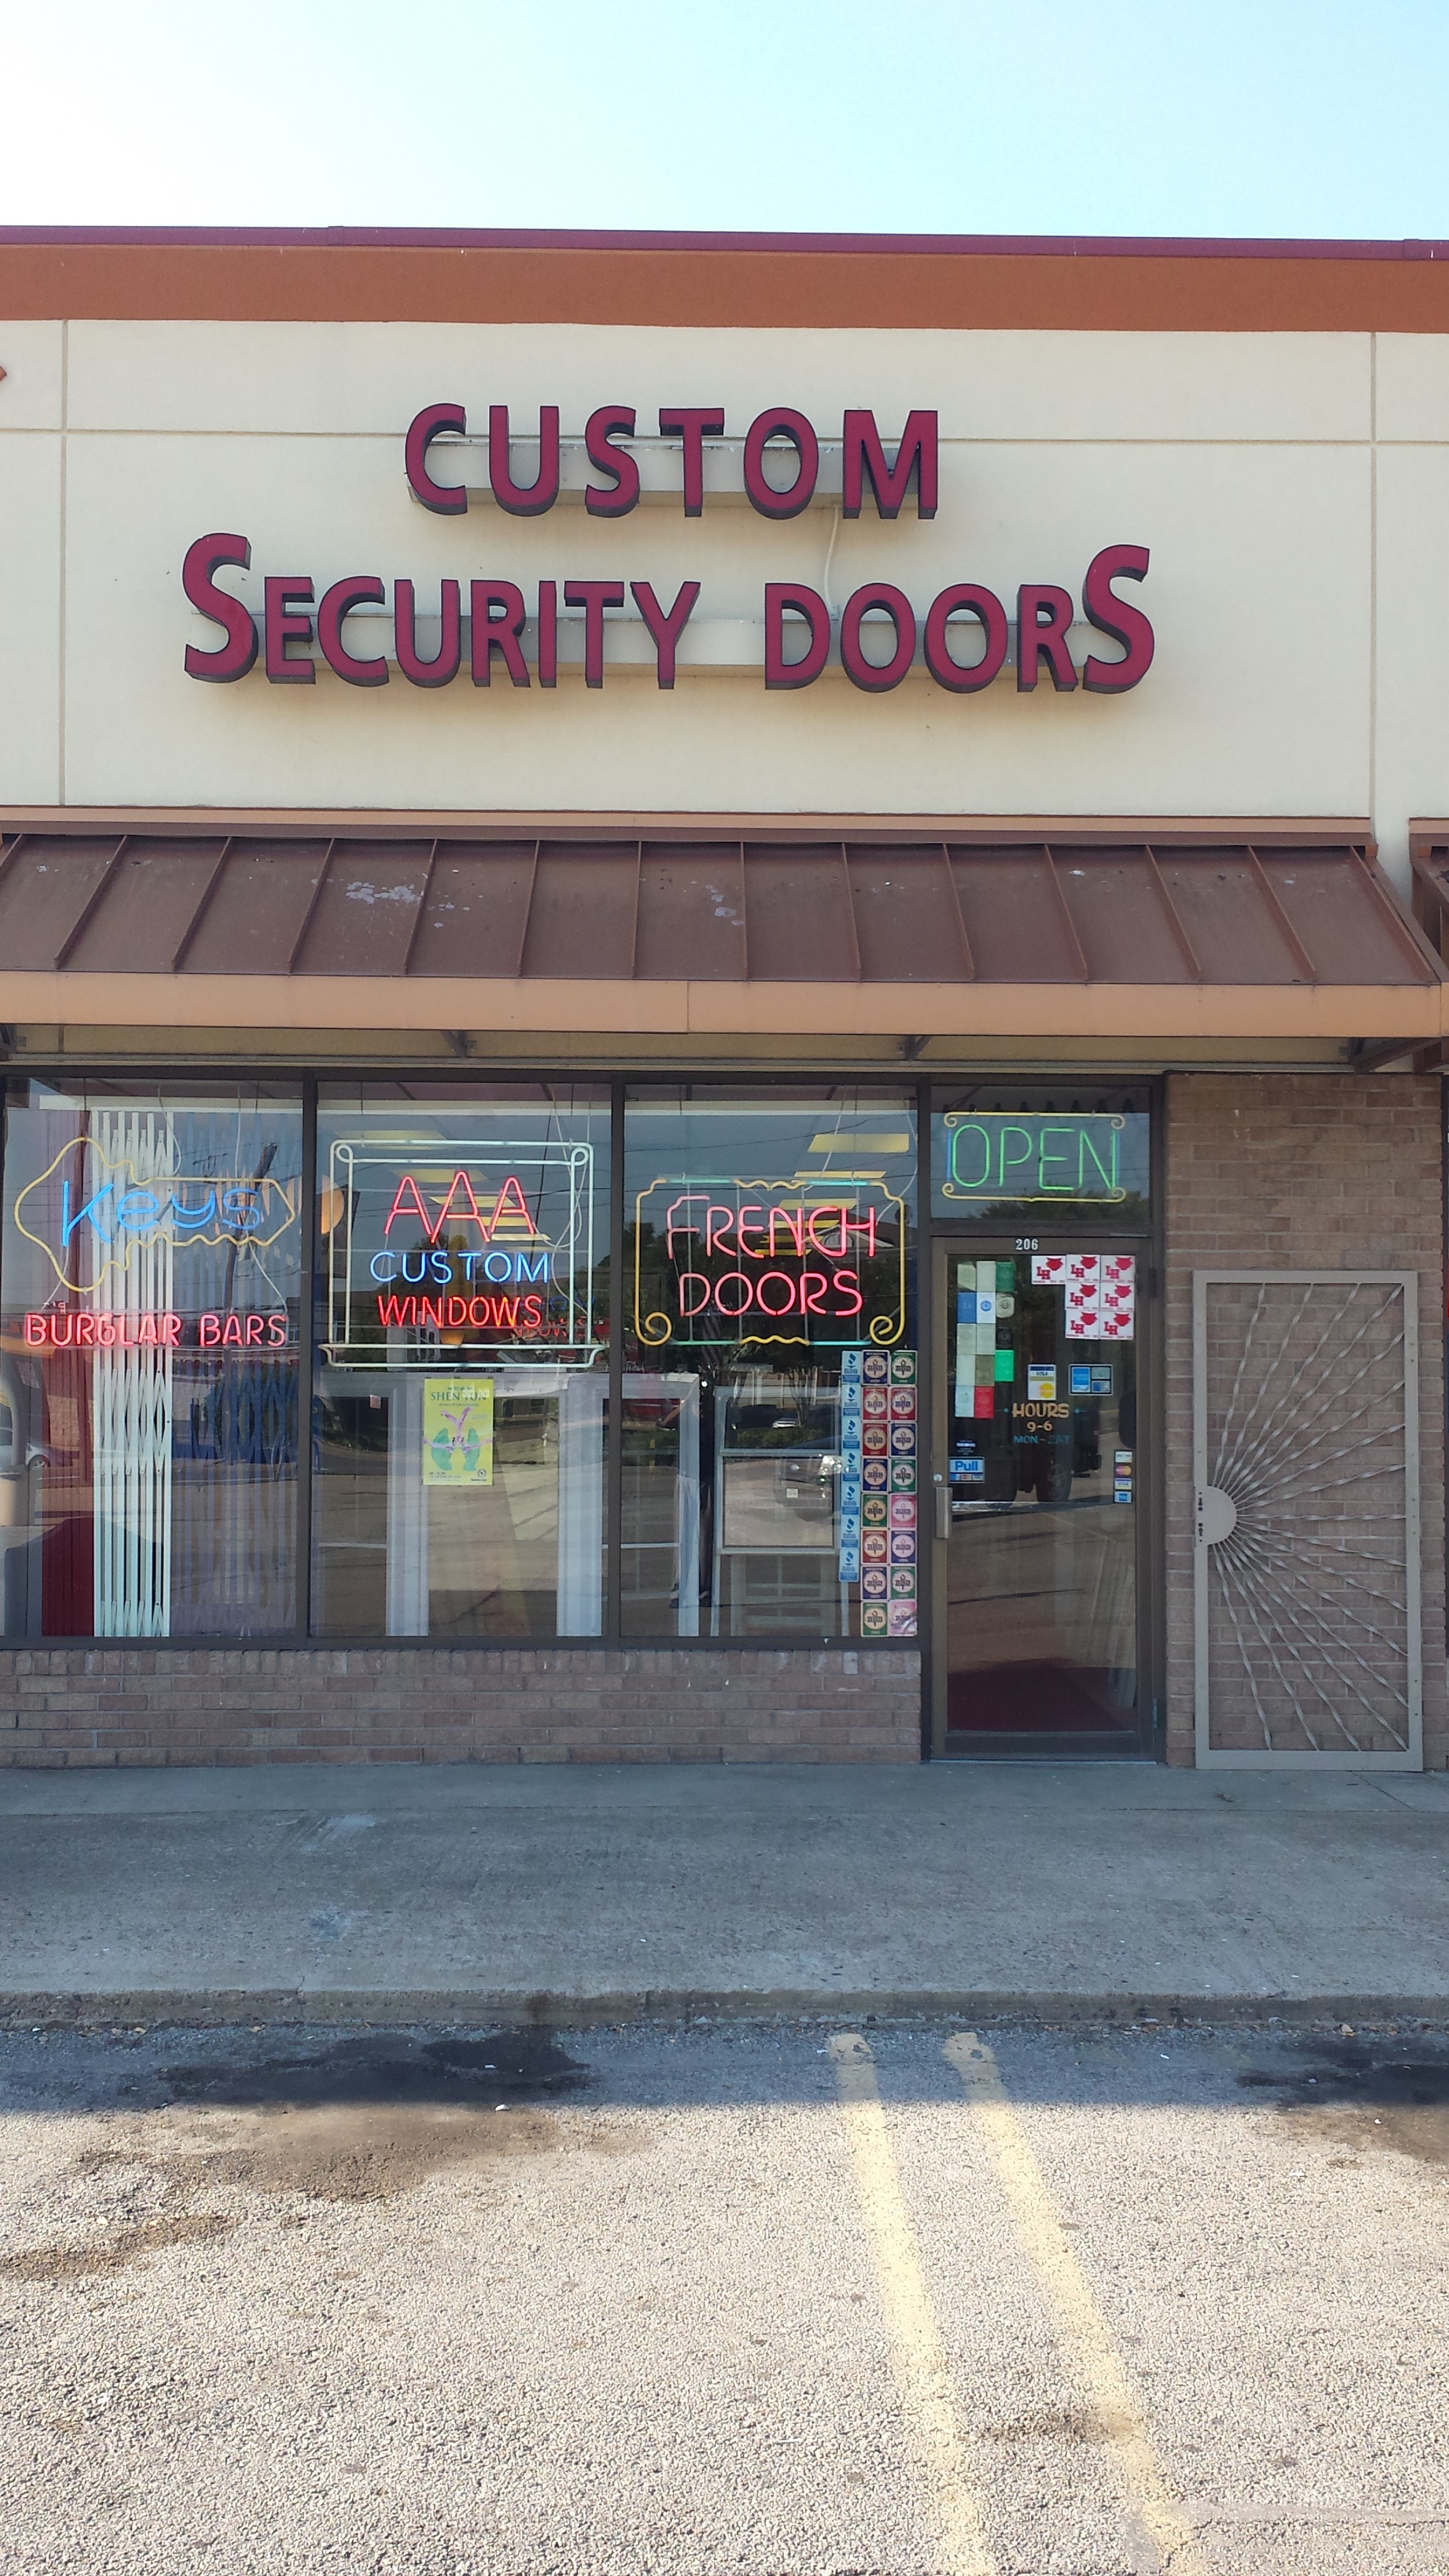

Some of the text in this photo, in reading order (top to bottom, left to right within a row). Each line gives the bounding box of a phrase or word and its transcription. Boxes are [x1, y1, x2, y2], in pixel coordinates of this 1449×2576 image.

[406, 403, 938, 520] CUSTOM
[182, 532, 1156, 694] SECURITY DOORS
[952, 1125, 1116, 1191] OPEN
[62, 1180, 261, 1247] Keys
[384, 1171, 535, 1242] AAA
[666, 1194, 876, 1259] FRENCH
[1015, 1239, 1039, 1251] 206
[369, 1251, 550, 1284] CUSTOM
[679, 1271, 864, 1317] DOORS
[378, 1295, 542, 1328] WINDOWS
[26, 1314, 287, 1347] BURGLAR BARS
[431, 1392, 460, 1401] SHEN
[1012, 1403, 1069, 1418] HOURS
[1027, 1420, 1052, 1432] 9-6
[955, 1461, 978, 1471] Pull
